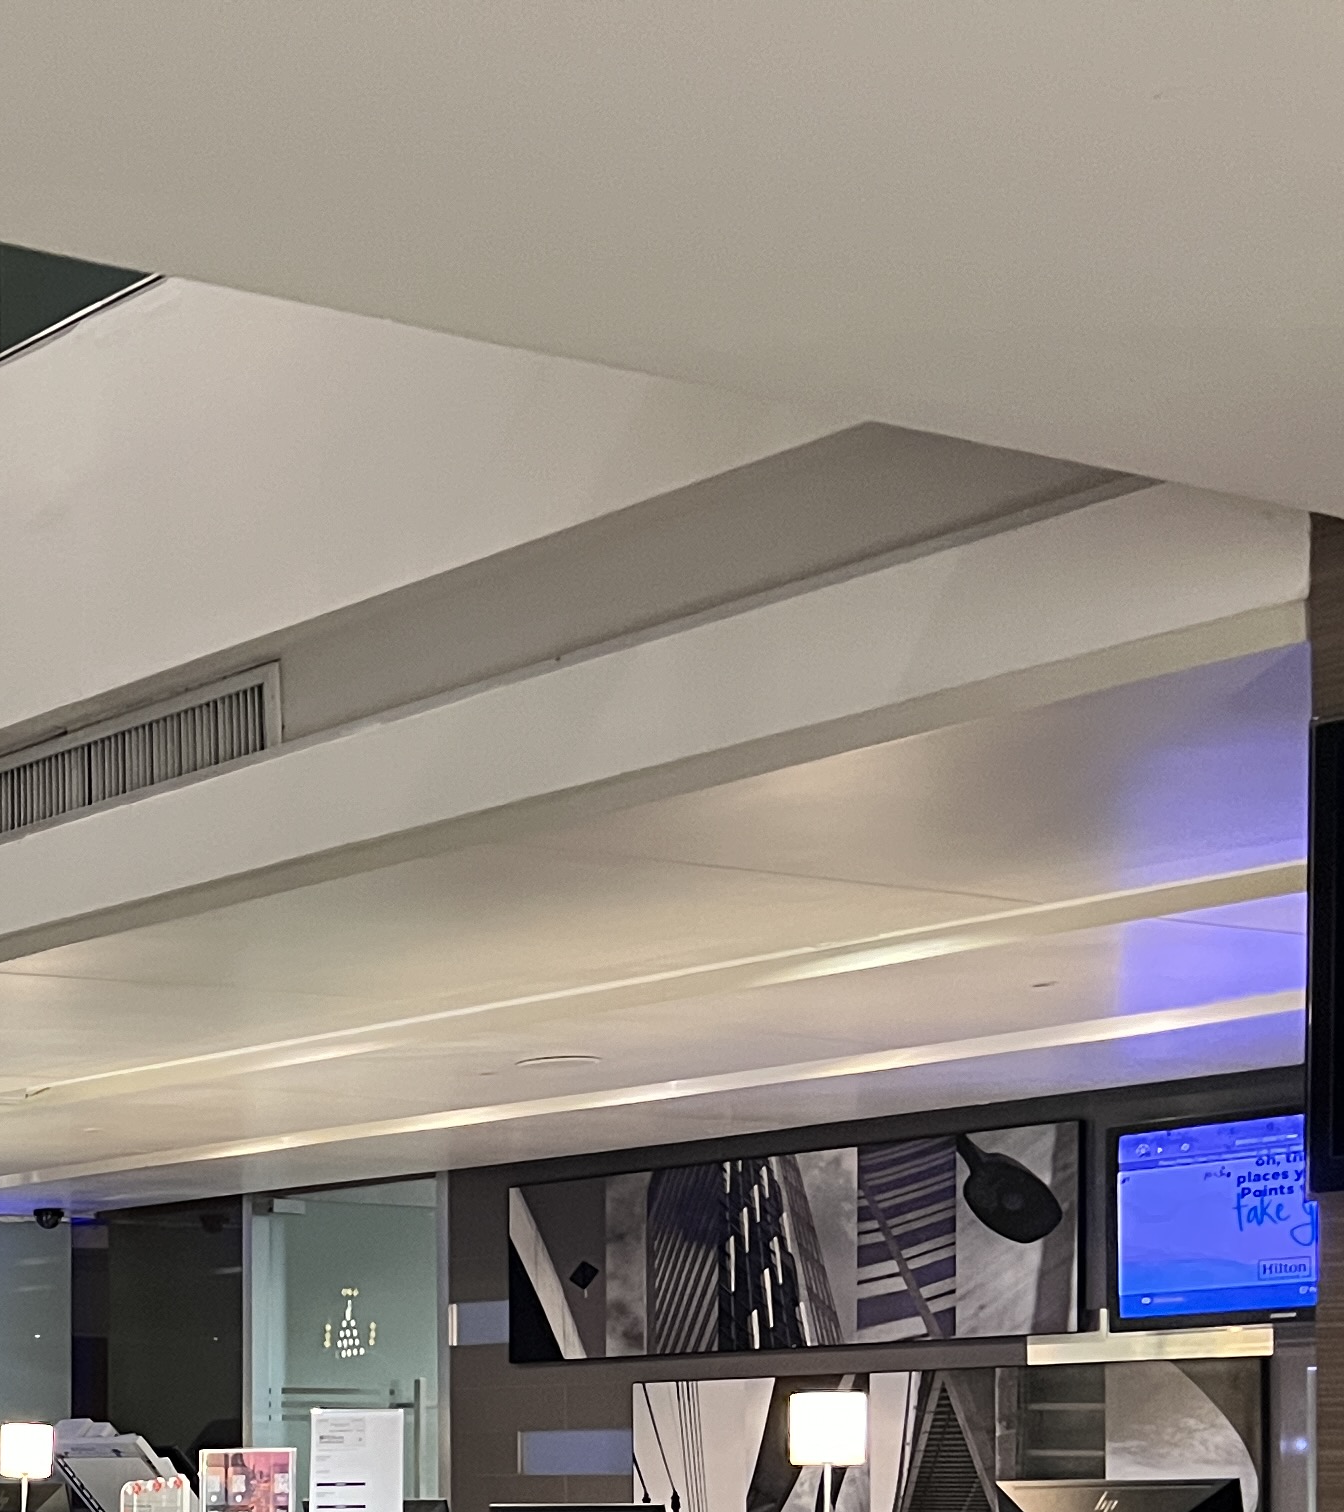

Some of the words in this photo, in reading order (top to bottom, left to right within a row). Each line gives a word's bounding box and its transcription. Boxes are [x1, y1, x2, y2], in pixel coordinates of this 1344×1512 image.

[1237, 1170, 1290, 1187] places
[1241, 1184, 1295, 1198] Points
[1262, 1262, 1307, 1276] Hilton
